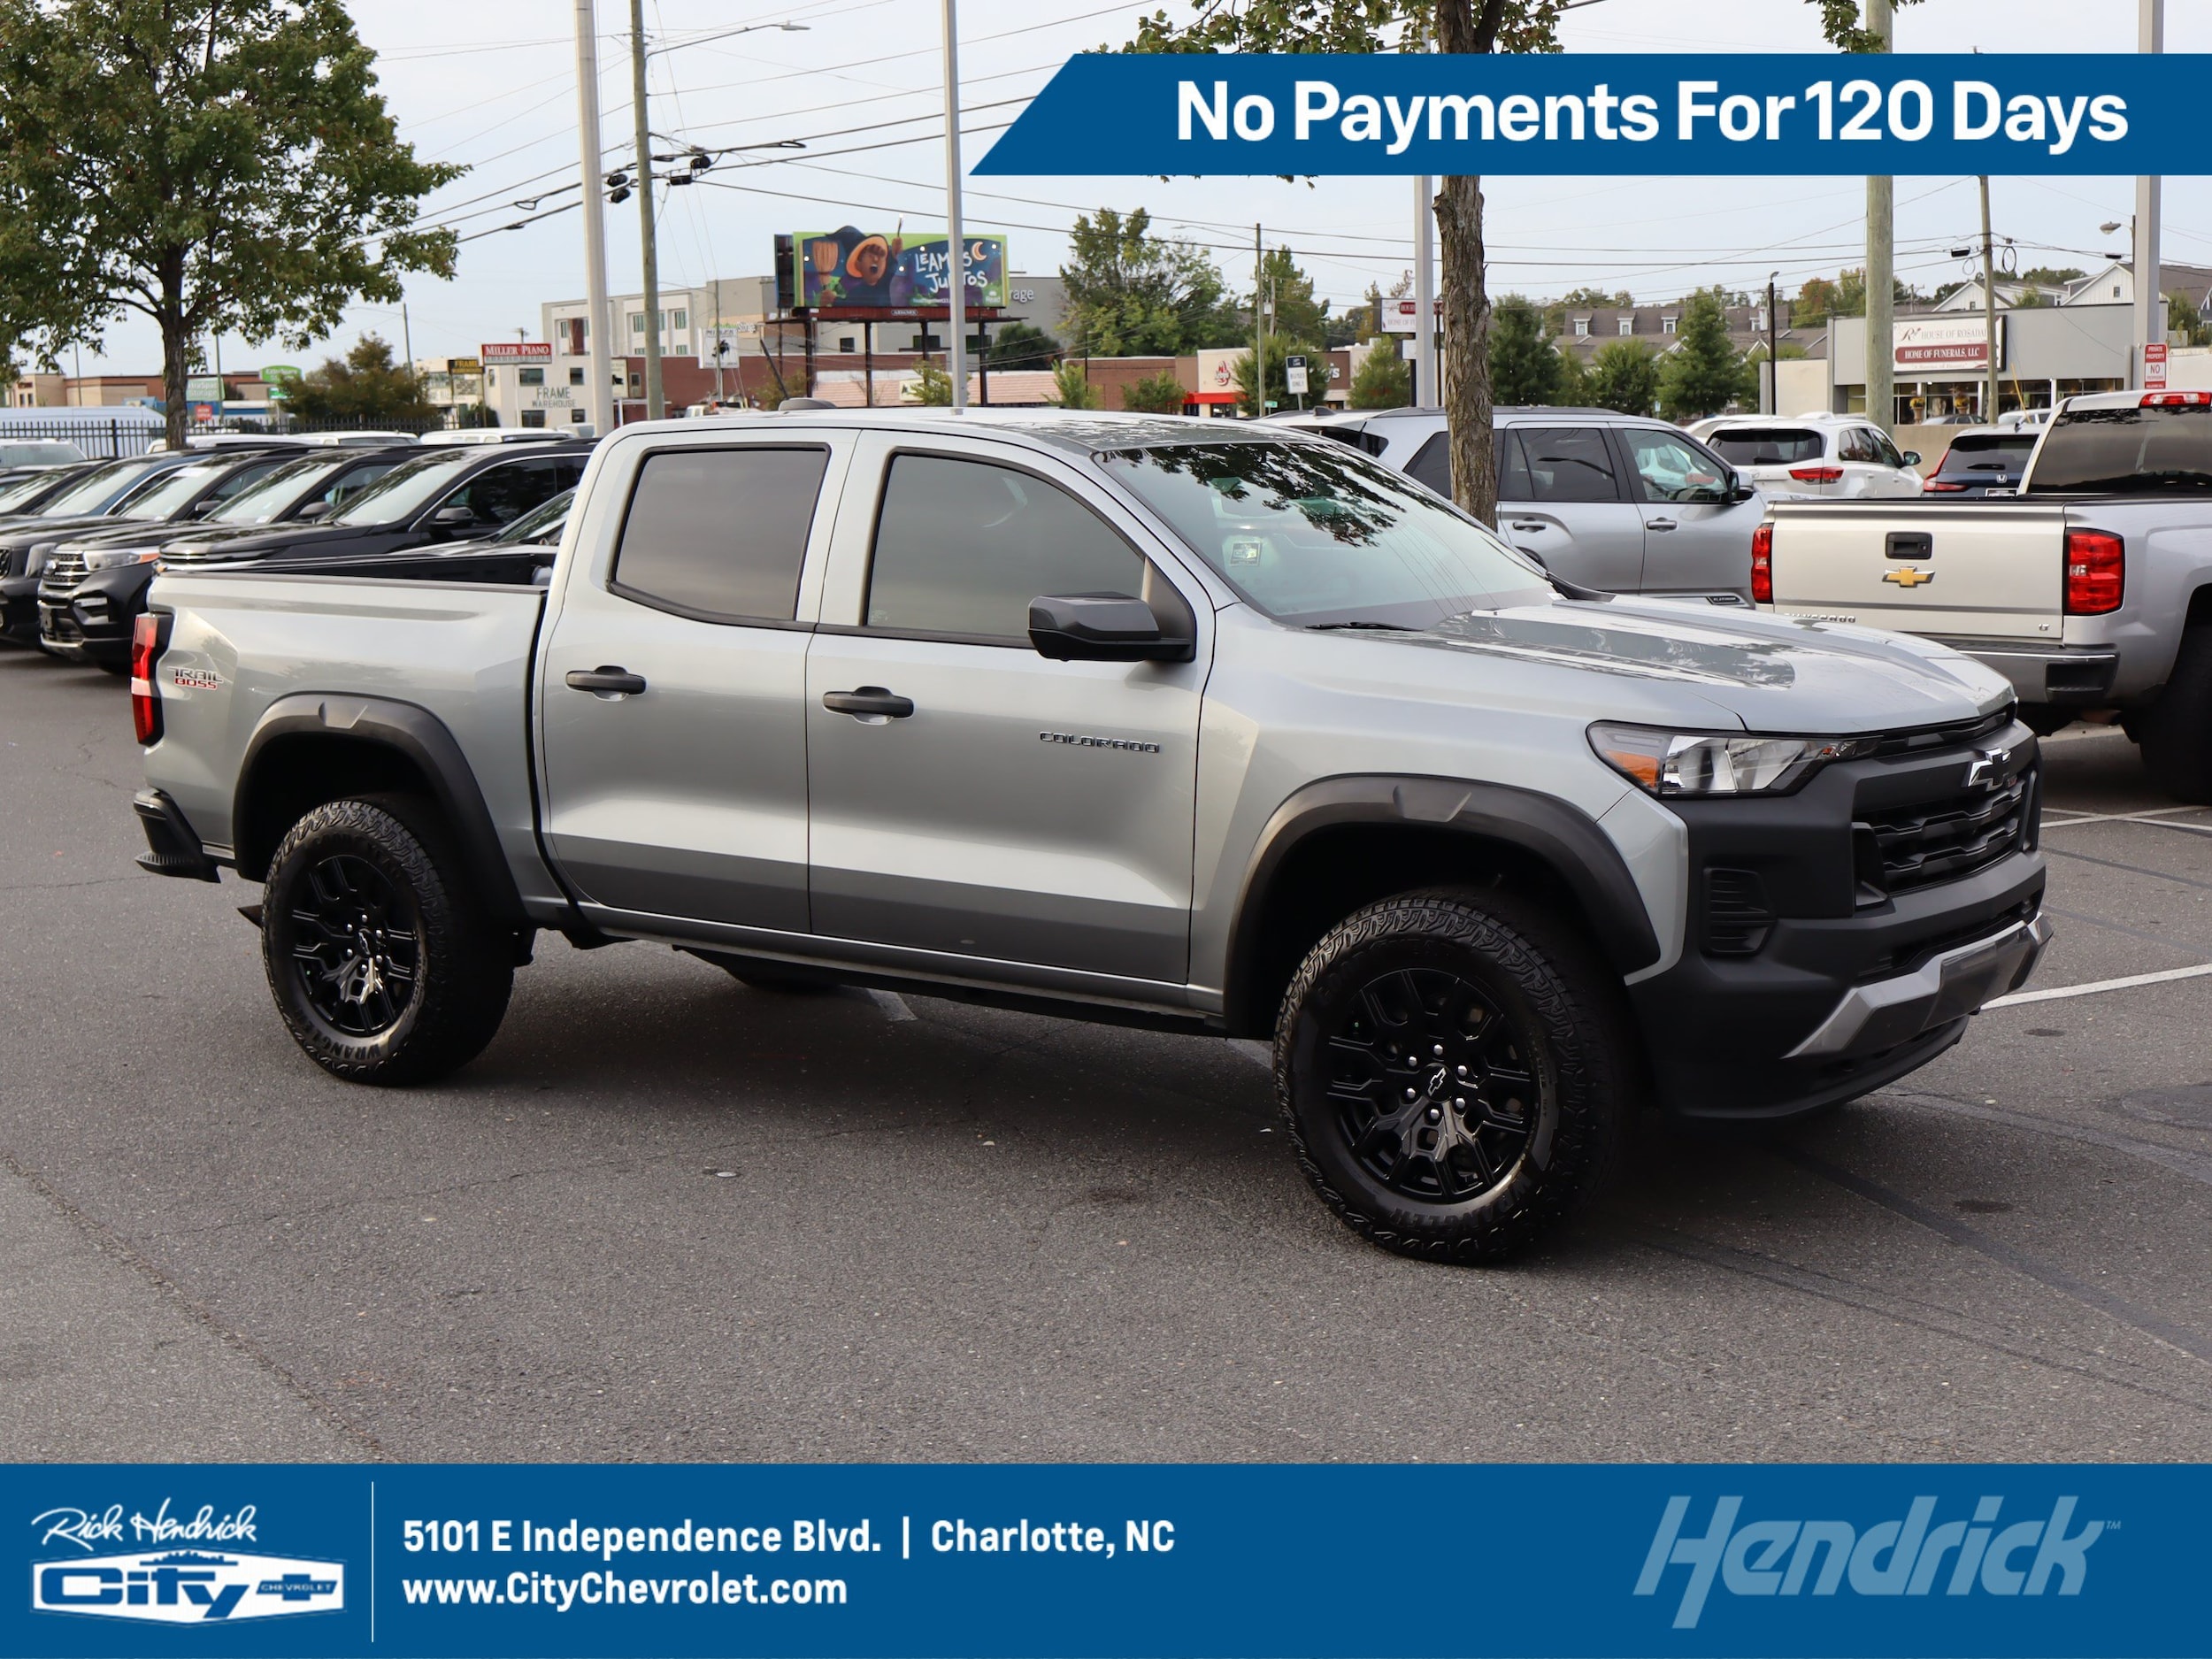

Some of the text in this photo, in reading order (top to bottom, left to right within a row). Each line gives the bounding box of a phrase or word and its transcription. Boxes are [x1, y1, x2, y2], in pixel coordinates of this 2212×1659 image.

[915, 251, 972, 273] LEAMS
[926, 270, 988, 294] JUTOS
[1921, 330, 1943, 340] HOUSE
[1946, 329, 1955, 338] OF
[522, 345, 549, 355] PIANO
[1904, 347, 1979, 359] HOME OF FUNERALS, LLC
[2150, 365, 2161, 373] NO
[536, 387, 571, 398] FRAME
[532, 398, 577, 408] WAREHOUSE
[166, 666, 224, 683] TRAIL
[174, 678, 218, 690] BOSS
[1040, 731, 1160, 753] COLORADO
